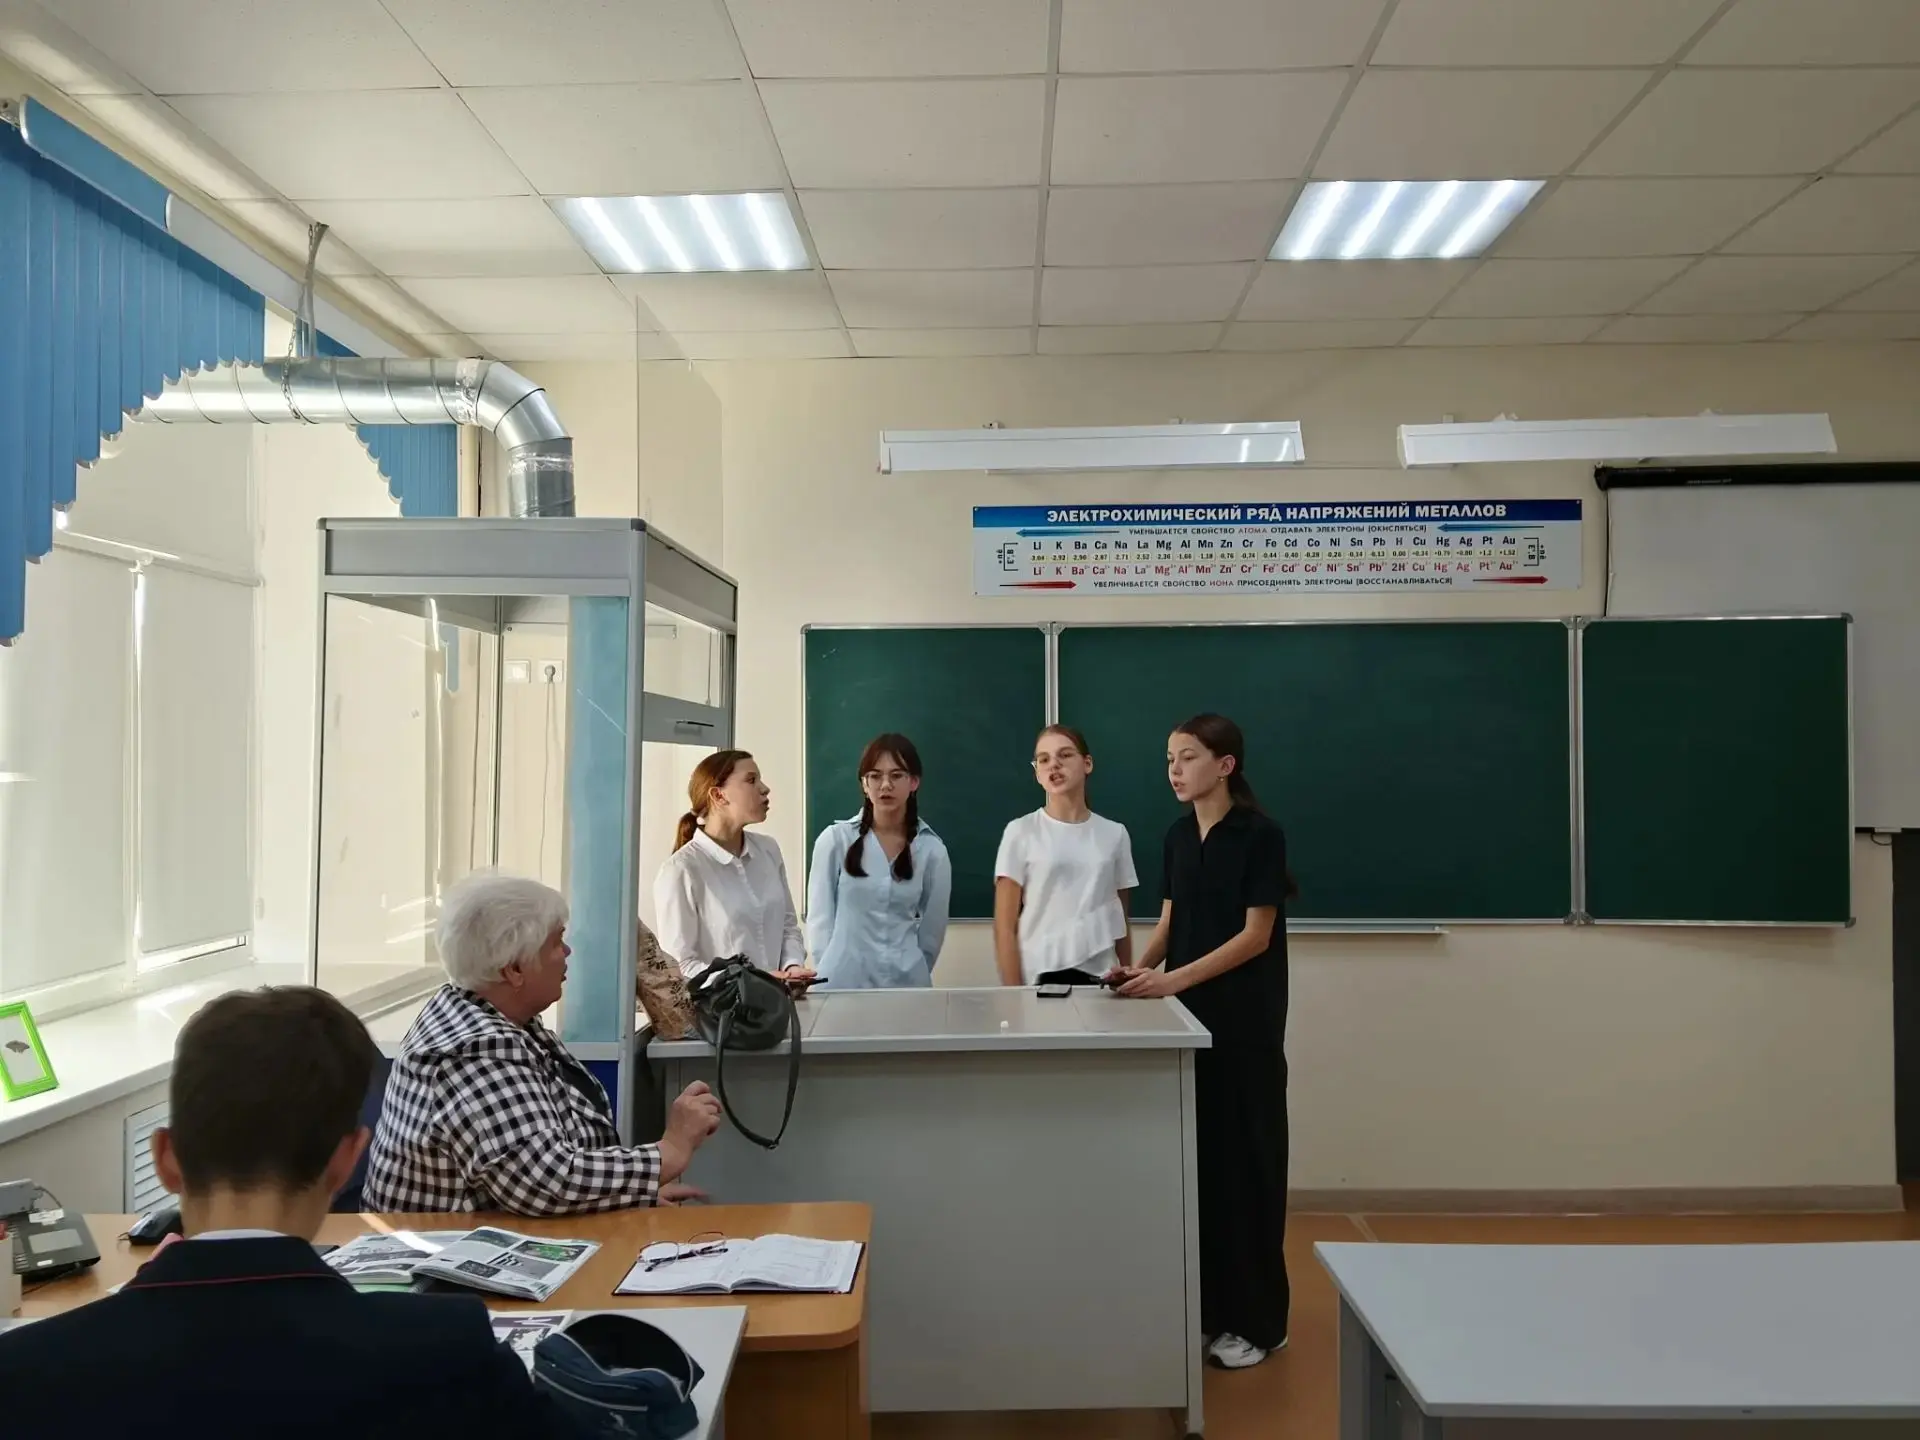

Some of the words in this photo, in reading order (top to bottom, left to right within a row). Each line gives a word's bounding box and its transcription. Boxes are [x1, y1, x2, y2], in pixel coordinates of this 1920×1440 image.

[1047, 505, 1241, 522] ЭЛЕКТРОХИМИЧЕСКИЙ
[1246, 507, 1282, 521] РЯД
[1286, 503, 1410, 519] НАПРЯЖЕНИЙ
[1415, 504, 1507, 518] МЕТАЛЛОВ
[1129, 527, 1188, 535] УМЕНЬШАЕТСЯ
[1191, 526, 1235, 534] СВОЙСТВО
[1271, 526, 1313, 534] ОТДАВАТЬ
[1316, 525, 1365, 533] ЭЛЕКТРОНЫ
[1033, 541, 1041, 550] Li
[1056, 541, 1062, 549] K
[1074, 541, 1087, 549] Ba
[1095, 540, 1107, 549] Ca
[1114, 540, 1127, 549] Na
[1138, 540, 1149, 549] La
[1156, 540, 1171, 550] Mg
[1181, 540, 1190, 549] Al
[1198, 540, 1213, 548] Mn
[1220, 539, 1233, 548] Zn
[1242, 539, 1253, 548] Cr
[1266, 539, 1277, 547] Fe
[1284, 538, 1297, 547] Cd
[1307, 538, 1320, 547] Co
[1330, 538, 1340, 546] Ni
[1350, 538, 1363, 546] Sn
[1373, 537, 1385, 546] Pb
[1396, 537, 1403, 546] H
[1413, 537, 1426, 546] Cu
[1436, 537, 1450, 547] Hg
[1459, 537, 1473, 547] Ag
[1482, 536, 1493, 545] Pt
[1502, 536, 1516, 545] Au
[1093, 580, 1159, 588] УВЕЛИЧИВАЕТСЯ
[1162, 579, 1206, 587] СВОЙСТВО
[1209, 579, 1234, 587] ИОНА
[1237, 579, 1301, 587] ПРИСОЕДИНЯТЬ
[1305, 578, 1353, 586] ЭЛЕКТРОНЫ
